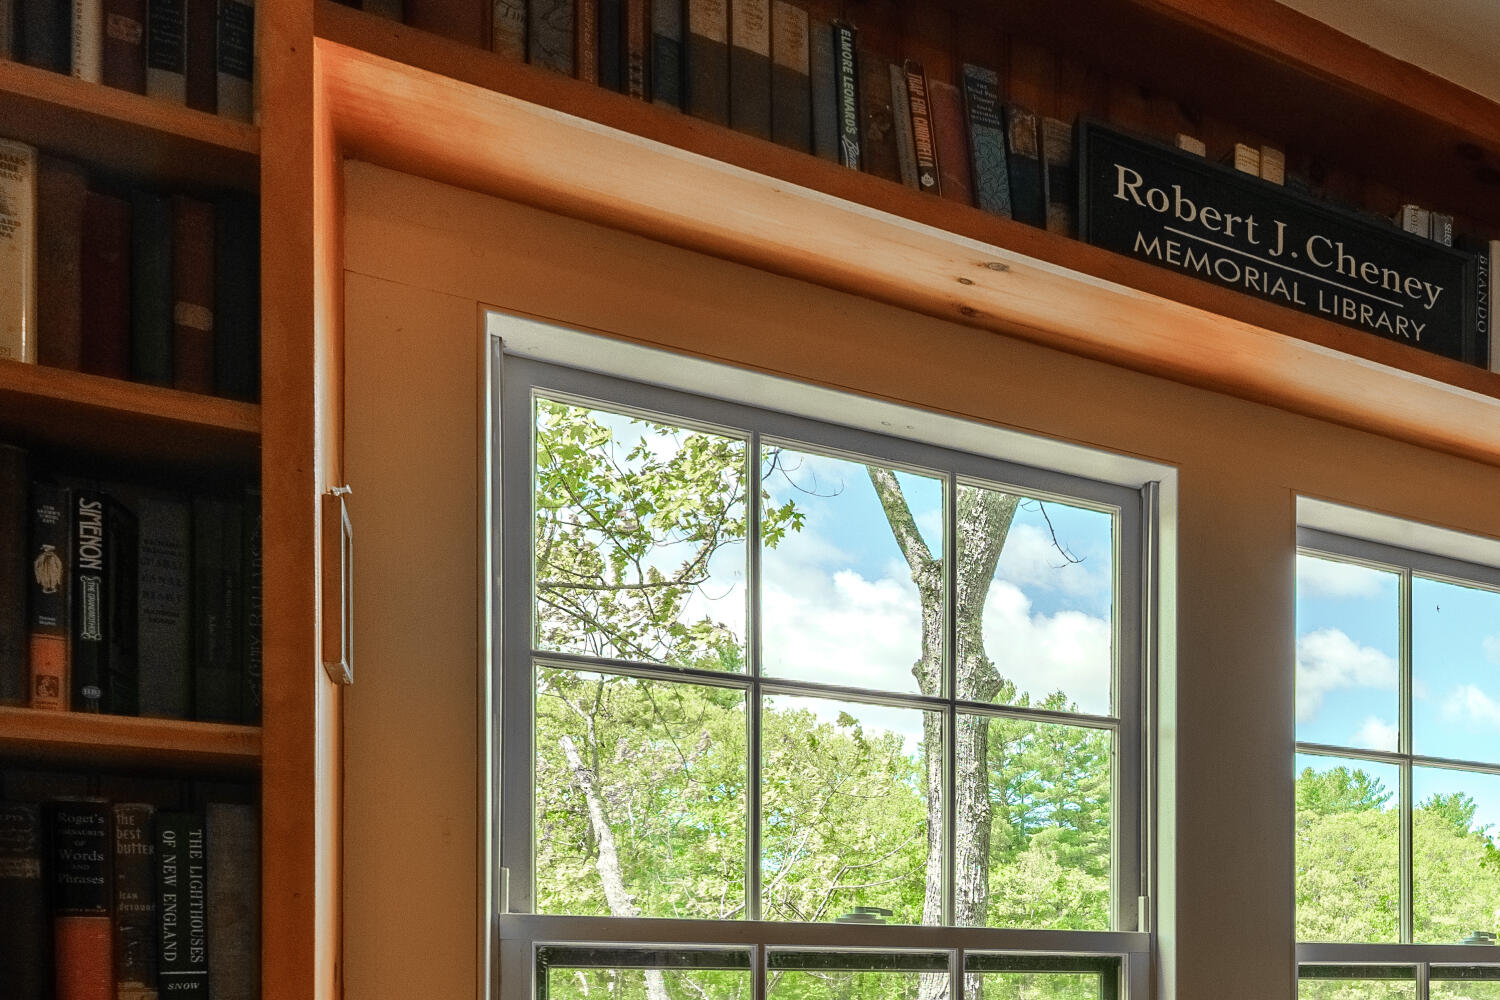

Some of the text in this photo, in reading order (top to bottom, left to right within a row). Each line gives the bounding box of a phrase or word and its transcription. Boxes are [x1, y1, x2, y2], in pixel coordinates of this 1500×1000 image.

[837, 28, 852, 73] ELMORE
[906, 71, 925, 99] TRAP
[1113, 163, 1443, 310] Robert J. Cheney
[1134, 232, 1427, 342] MEMORIAL LIBRARY
[1476, 254, 1488, 334] BRANDO
[80, 497, 102, 571] SIMENON
[59, 849, 104, 862] Words
[161, 830, 176, 961] OF NEW ENGLAND
[189, 829, 203, 963] THE LIGHTHOUSES
[168, 982, 200, 990] SNOW
